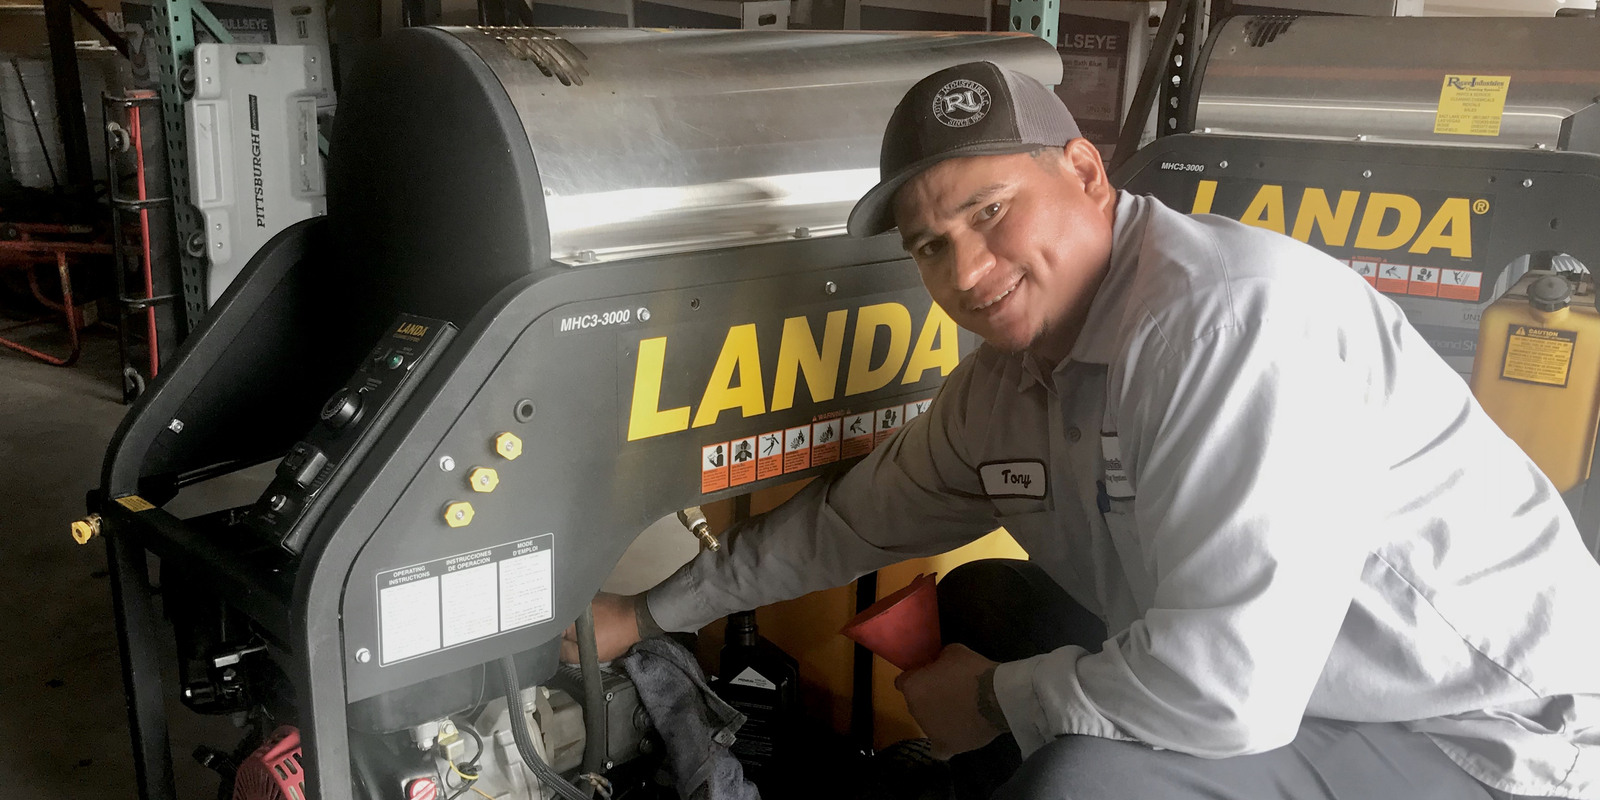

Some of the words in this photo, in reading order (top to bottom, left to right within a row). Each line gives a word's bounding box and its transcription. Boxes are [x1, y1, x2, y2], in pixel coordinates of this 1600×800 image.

[1058, 33, 1117, 50] LSEYE
[942, 90, 981, 114] RI
[1161, 162, 1204, 172] MHC3-3000
[251, 132, 265, 228] PITTSBURGH
[560, 309, 631, 332] MHC3-3000
[397, 322, 429, 337] LANDA
[1528, 328, 1558, 337] CAUTION
[627, 300, 960, 441] LANDA
[1001, 468, 1032, 489] Tony
[512, 545, 539, 556] D'EMPLOI
[517, 540, 534, 549] MODE
[446, 550, 492, 566] INSTRUCCIONES
[457, 557, 491, 571] OPERACION
[388, 571, 431, 586] INSTRUCTIONS
[393, 565, 426, 578] OPERATING
